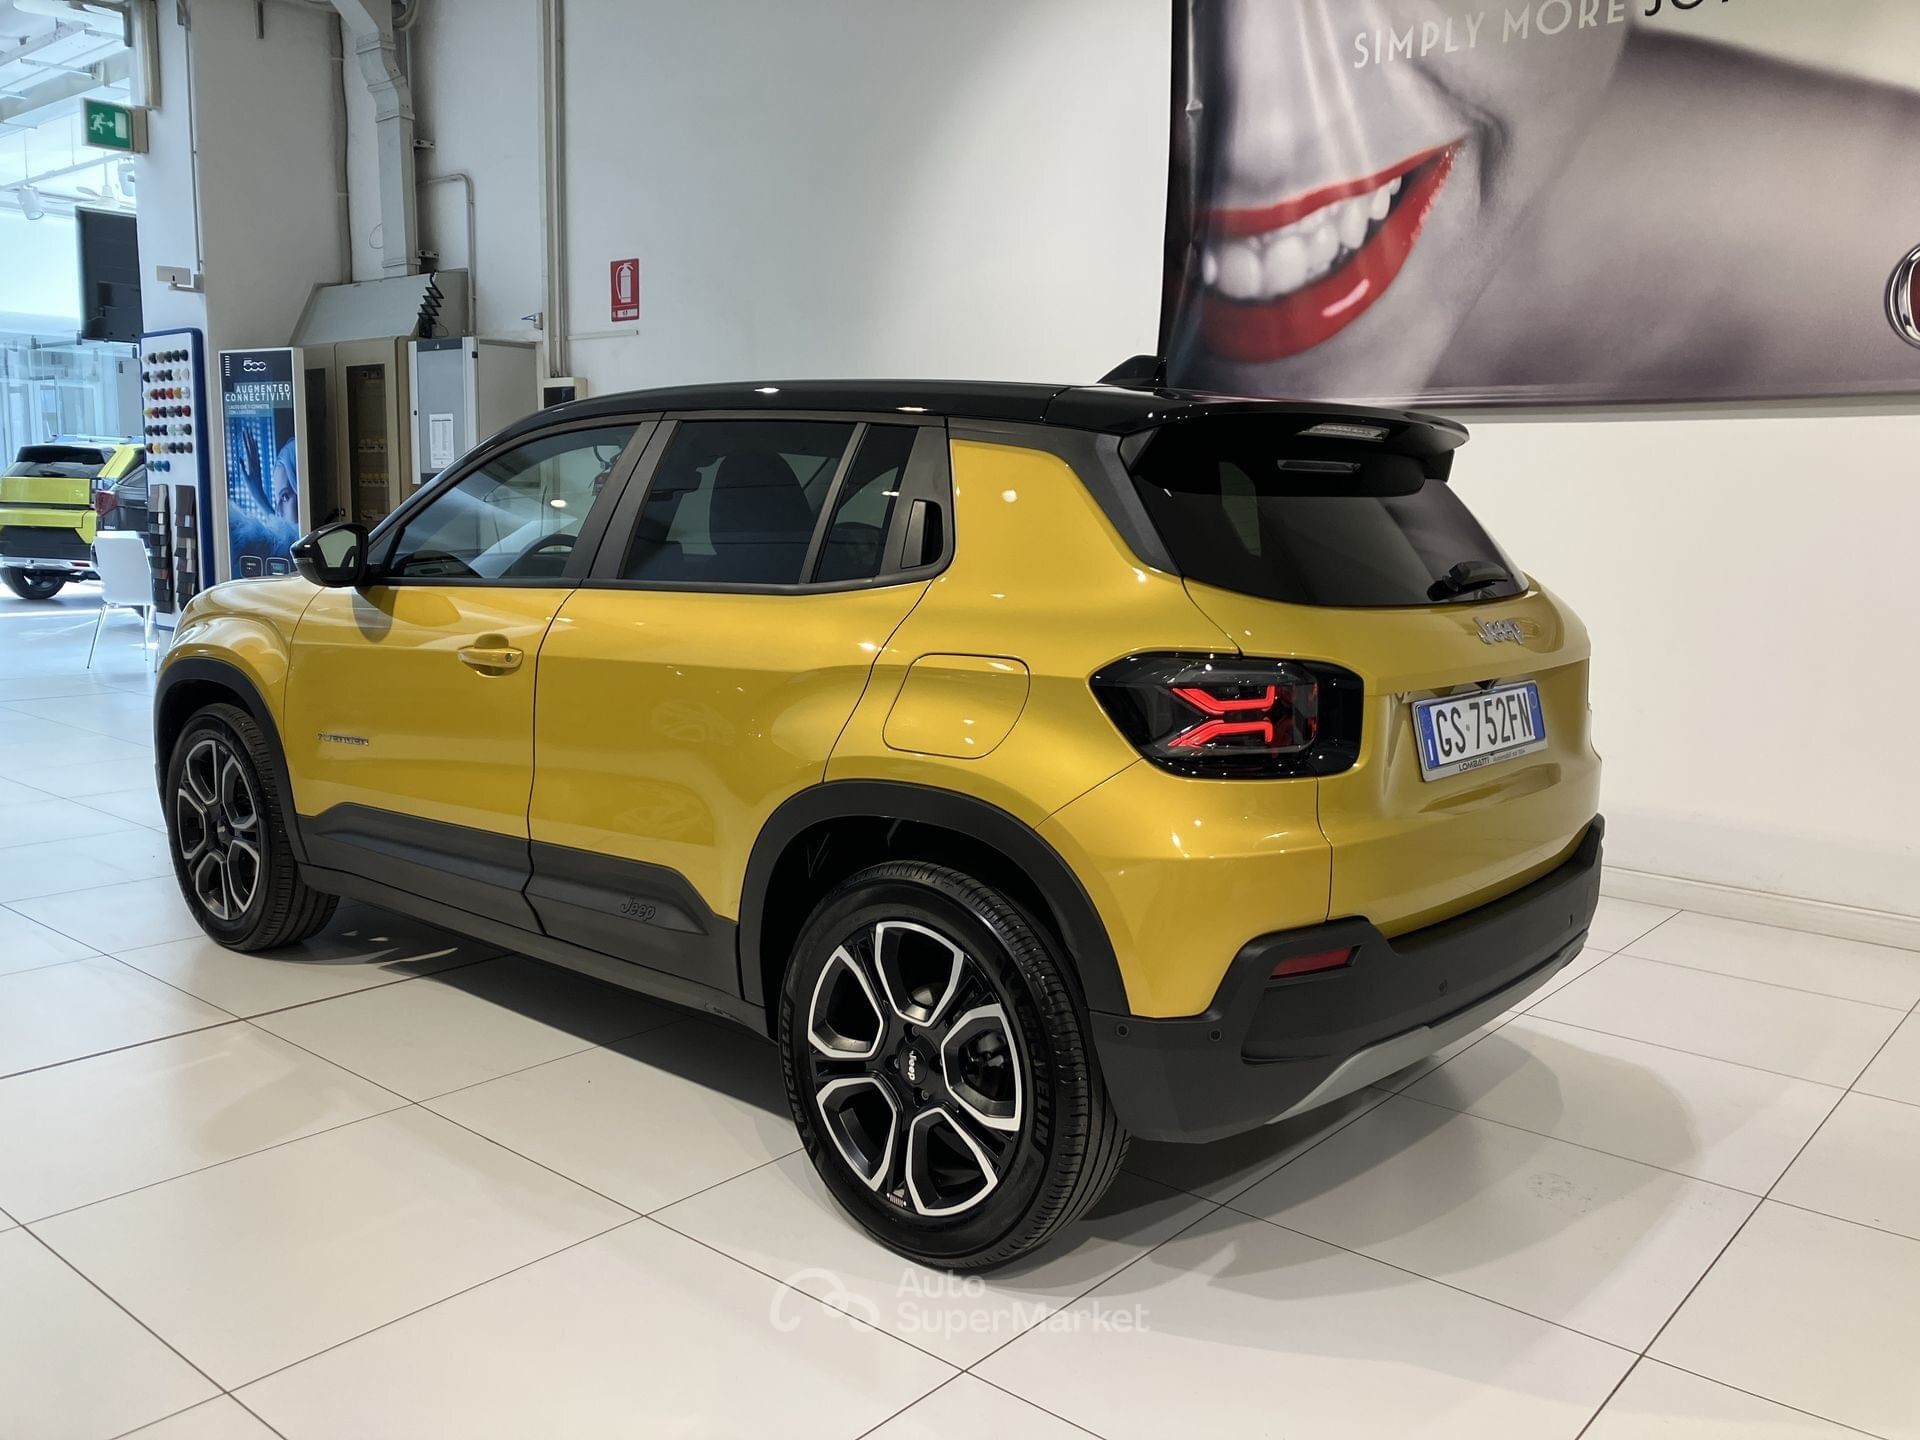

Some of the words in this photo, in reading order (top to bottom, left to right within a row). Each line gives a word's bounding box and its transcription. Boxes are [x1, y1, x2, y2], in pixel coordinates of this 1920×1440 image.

[1354, 12, 1485, 69] SIMPLY
[1502, 0, 1625, 43] MORE
[243, 357, 266, 371] 500
[225, 392, 291, 401] CONNECTIVITY
[236, 384, 290, 393] AUGMENTED
[1474, 616, 1525, 645] Jeep
[1458, 757, 1490, 772] LOMBATTI
[620, 896, 656, 922] Jeep
[907, 1050, 917, 1081] Jeep
